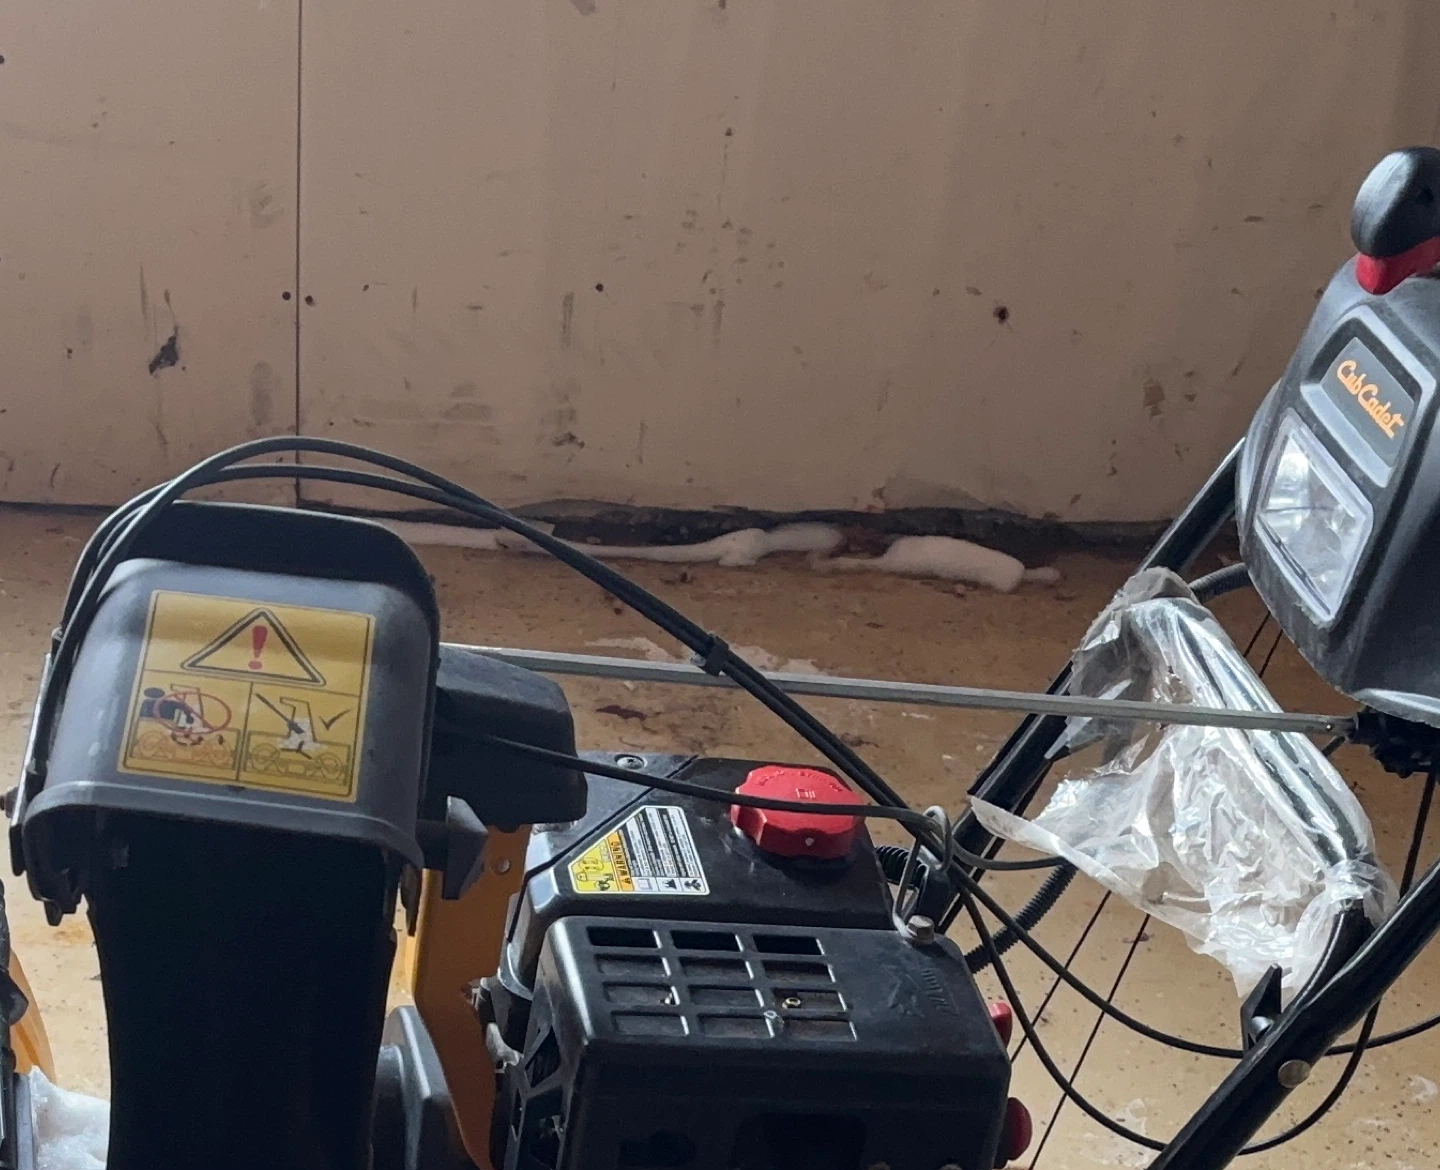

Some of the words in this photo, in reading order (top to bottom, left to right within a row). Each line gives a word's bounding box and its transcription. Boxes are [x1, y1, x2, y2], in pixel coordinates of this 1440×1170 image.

[1337, 360, 1366, 395] Cub
[1358, 384, 1404, 438] Cadet
[611, 841, 630, 877] WARNING
